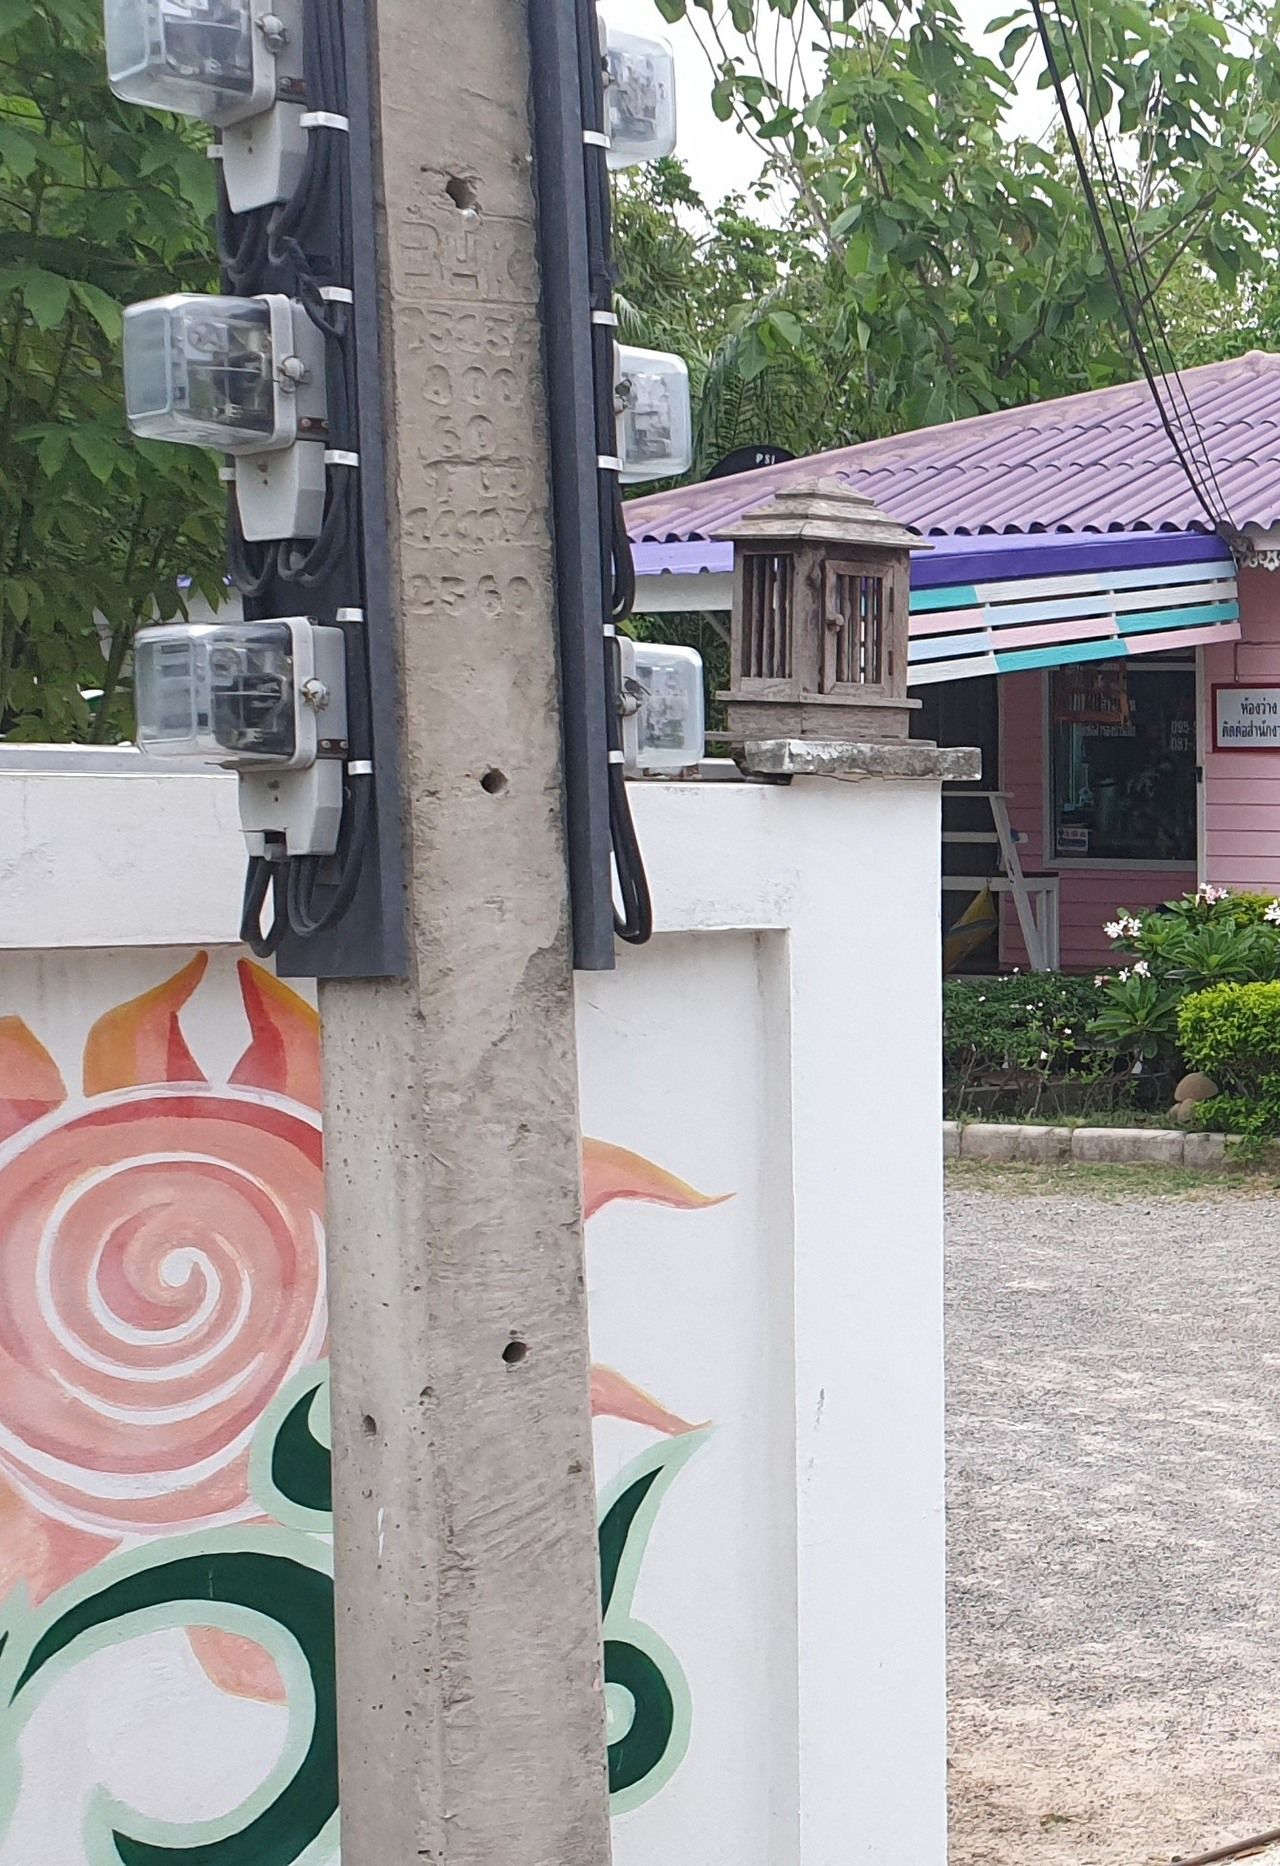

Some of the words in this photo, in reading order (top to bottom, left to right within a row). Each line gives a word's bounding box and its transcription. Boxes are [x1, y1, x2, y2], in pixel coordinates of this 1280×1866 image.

[755, 453, 776, 465] PSI
[1240, 697, 1278, 716] ห้องว่าง
